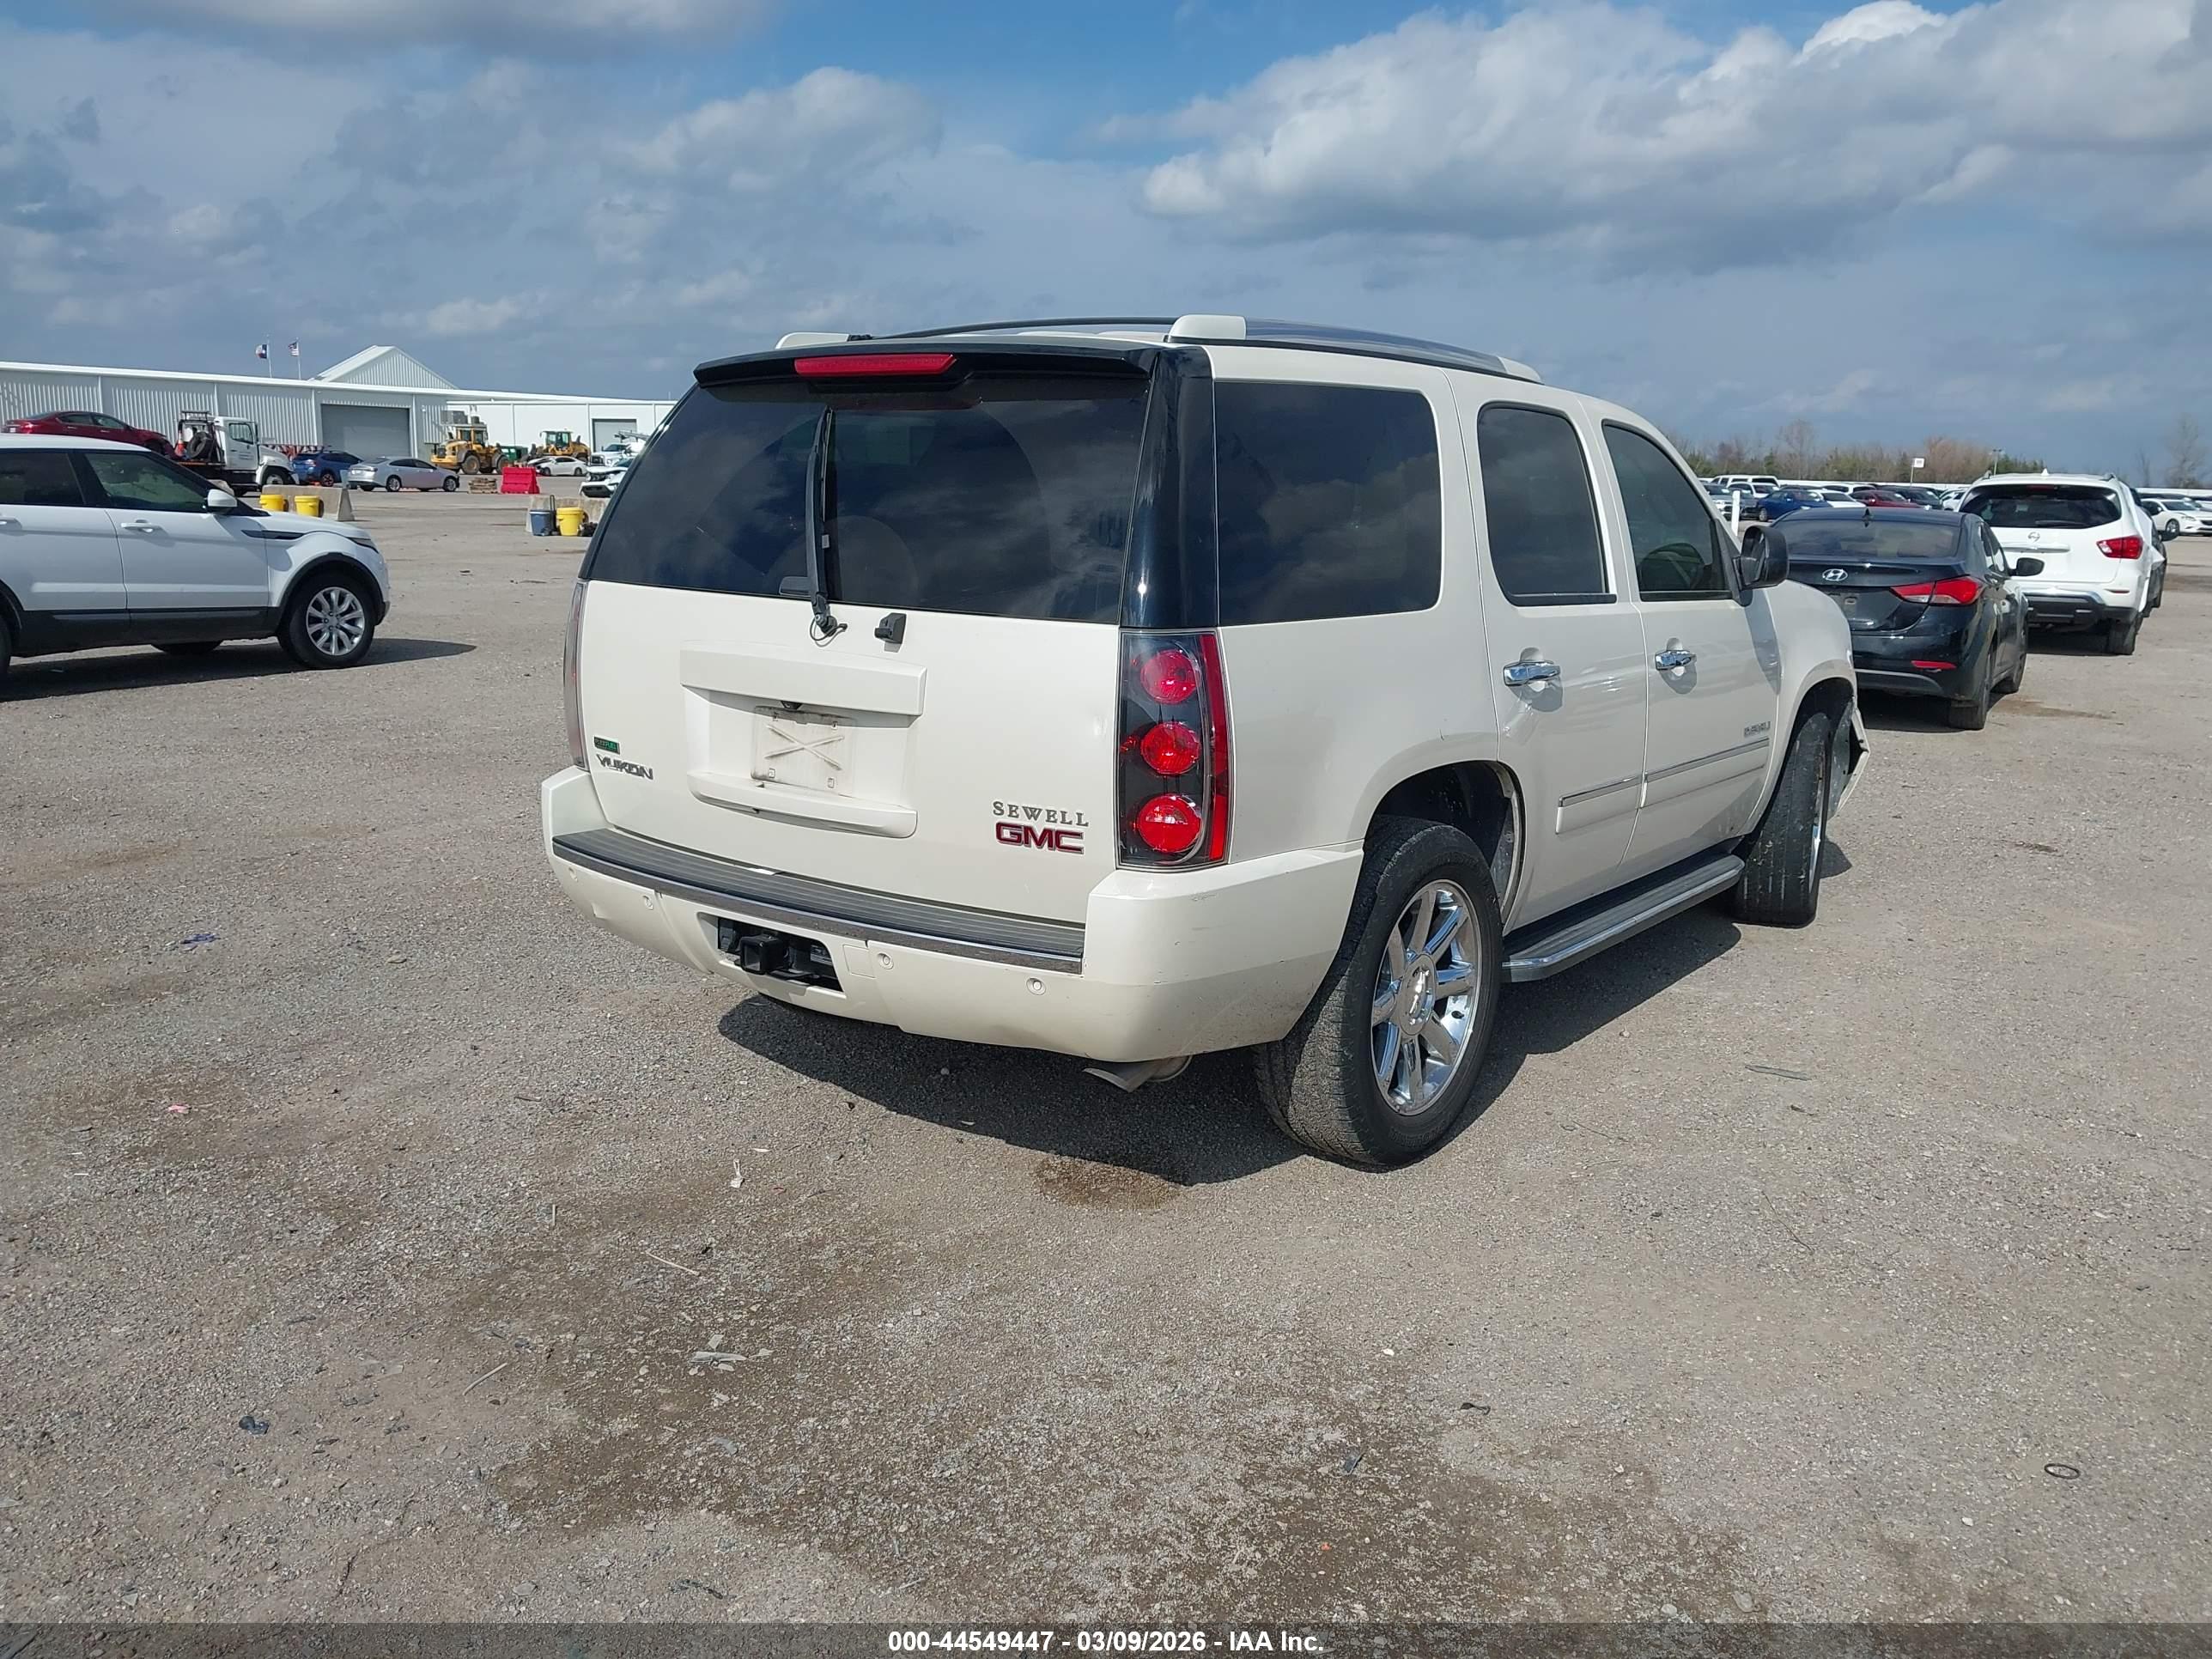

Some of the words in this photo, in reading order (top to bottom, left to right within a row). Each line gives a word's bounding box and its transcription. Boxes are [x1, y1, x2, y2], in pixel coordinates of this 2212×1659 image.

[596, 753, 653, 781] YUKON
[992, 800, 1089, 827] SEWELL
[995, 822, 1085, 855] GMC
